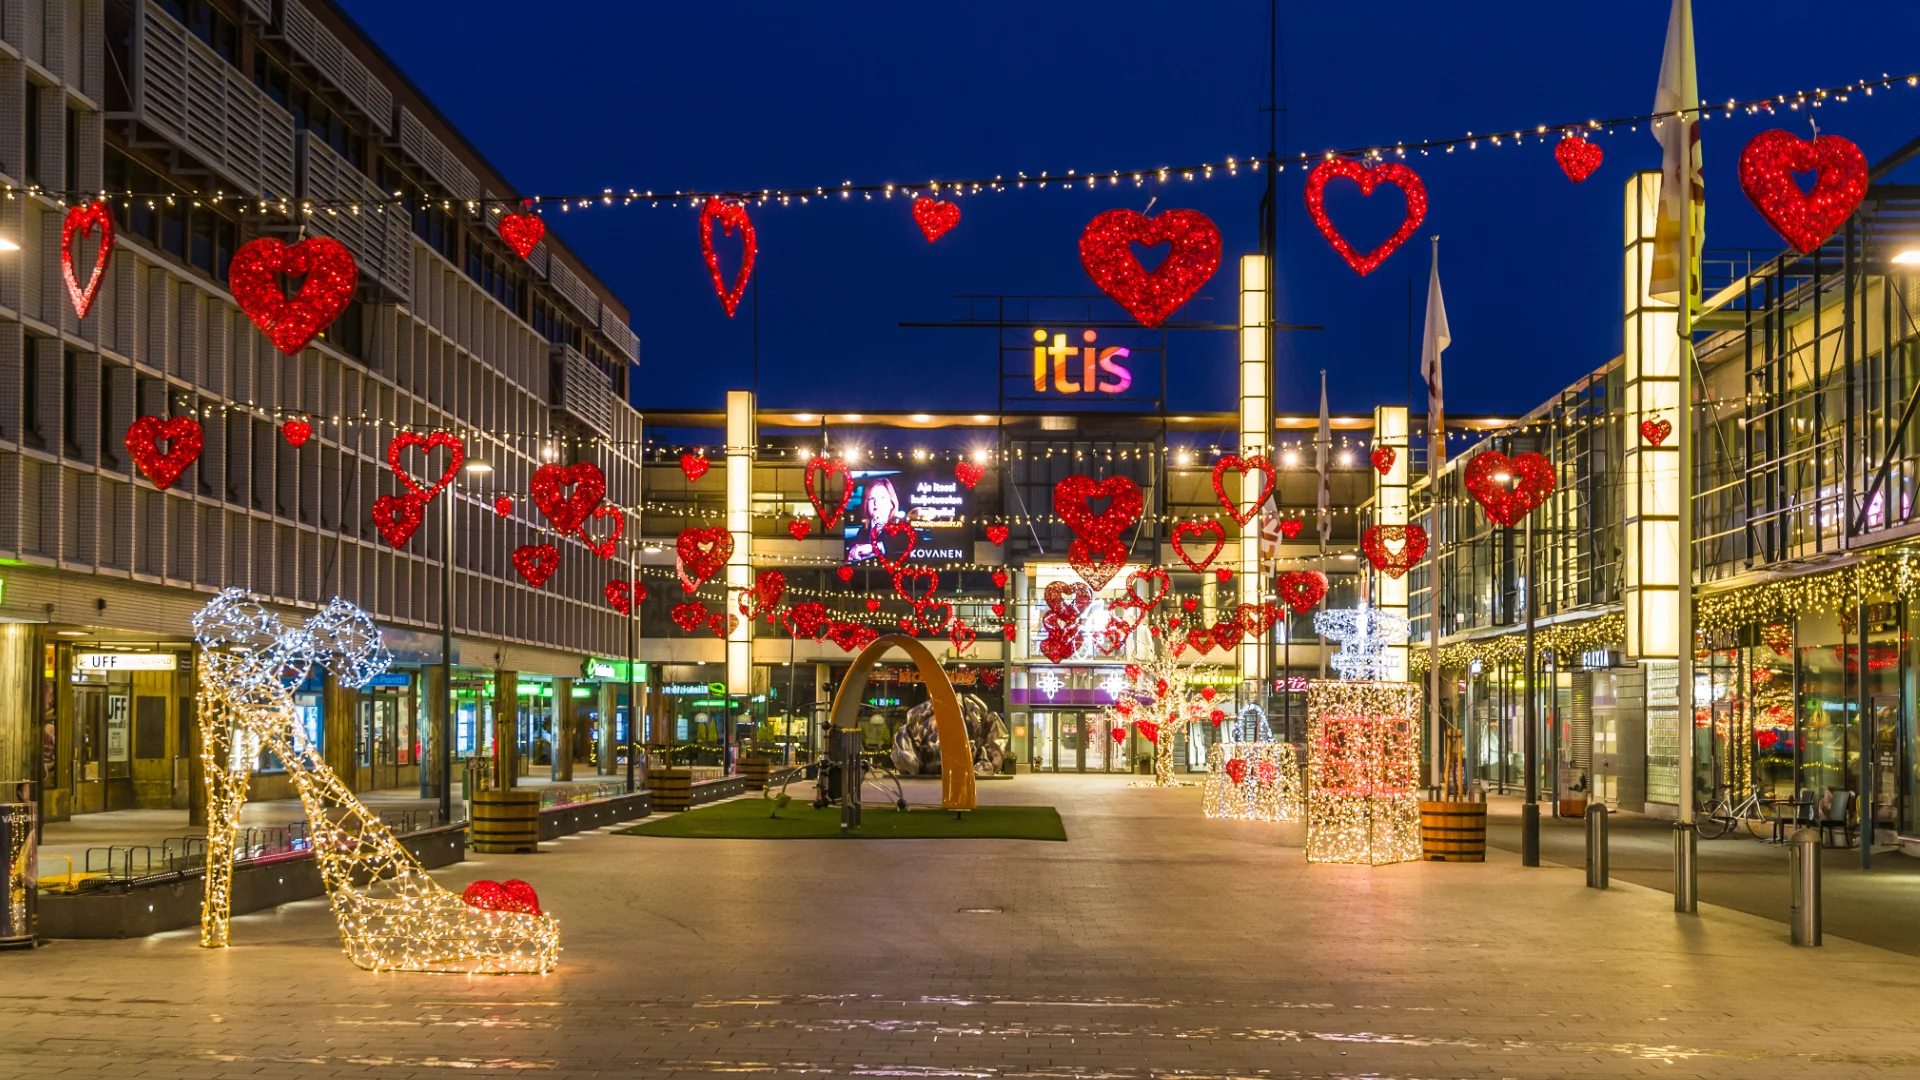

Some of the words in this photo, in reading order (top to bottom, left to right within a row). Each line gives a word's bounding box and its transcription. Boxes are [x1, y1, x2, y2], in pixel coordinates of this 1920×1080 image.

[1034, 329, 1131, 393] itis
[917, 482, 932, 494] Aja
[910, 549, 963, 558] KOVANEN
[92, 655, 117, 668] UFF
[381, 676, 406, 684] Pantti
